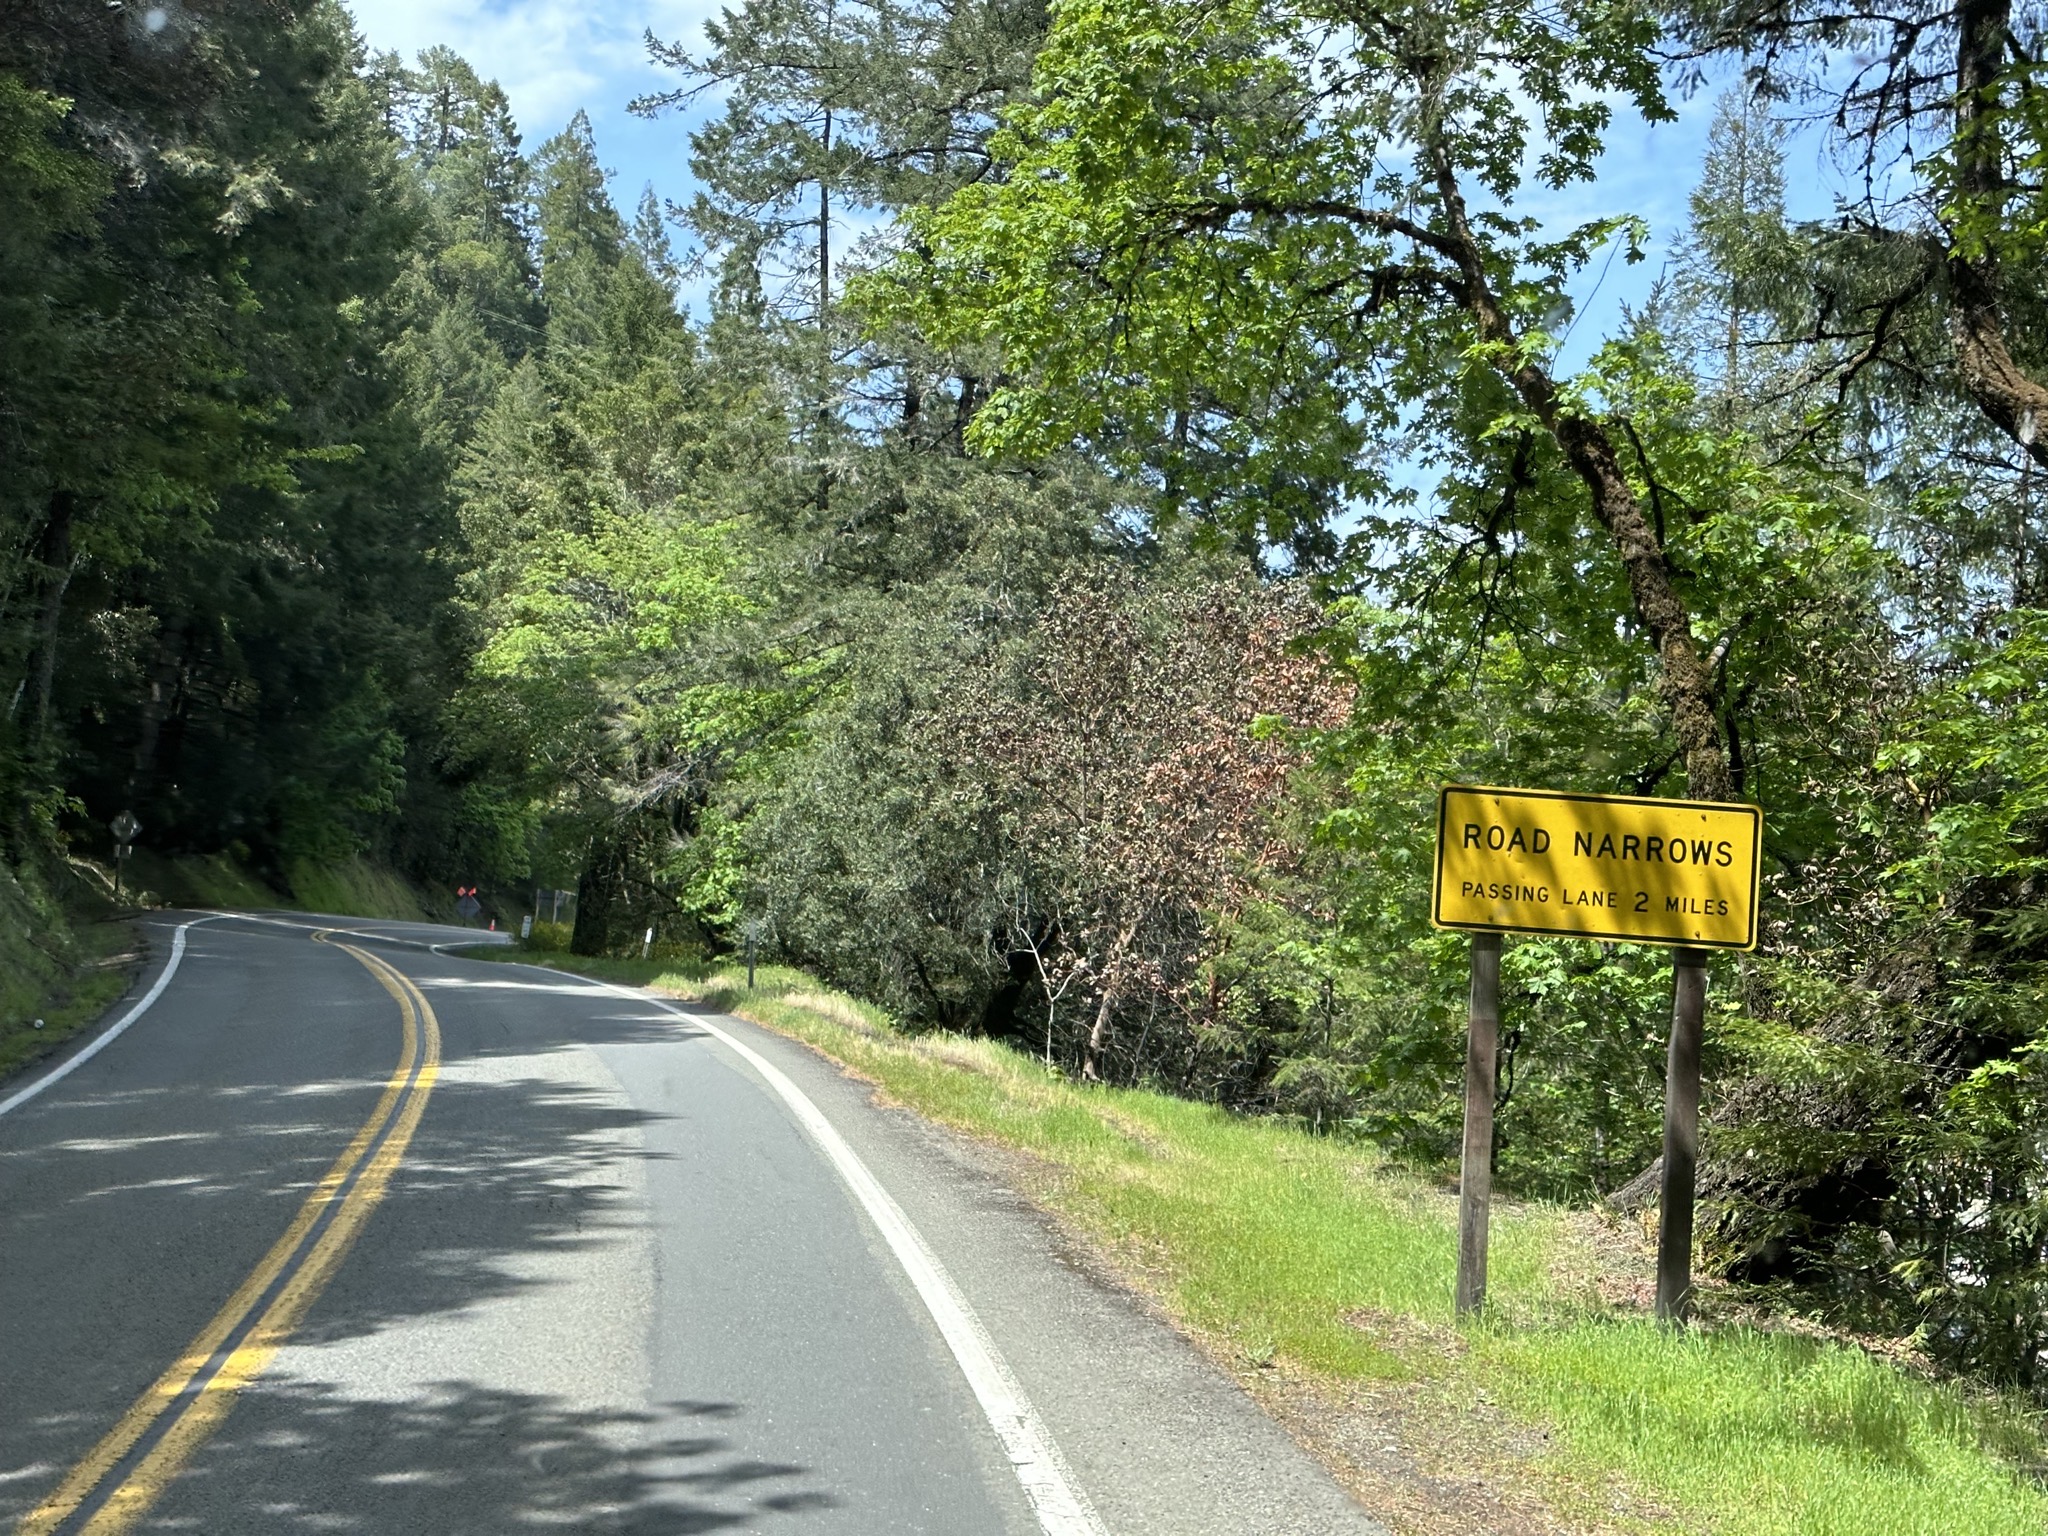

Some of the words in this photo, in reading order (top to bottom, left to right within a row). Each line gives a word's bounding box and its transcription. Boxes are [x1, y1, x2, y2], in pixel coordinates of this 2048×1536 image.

[1463, 823, 1551, 854] ROAD
[1573, 831, 1733, 867] NARROWS
[1461, 881, 1549, 903] PASSING
[1562, 889, 1617, 908] LANE
[1634, 891, 1649, 912] 2
[1665, 896, 1729, 916] MILES
